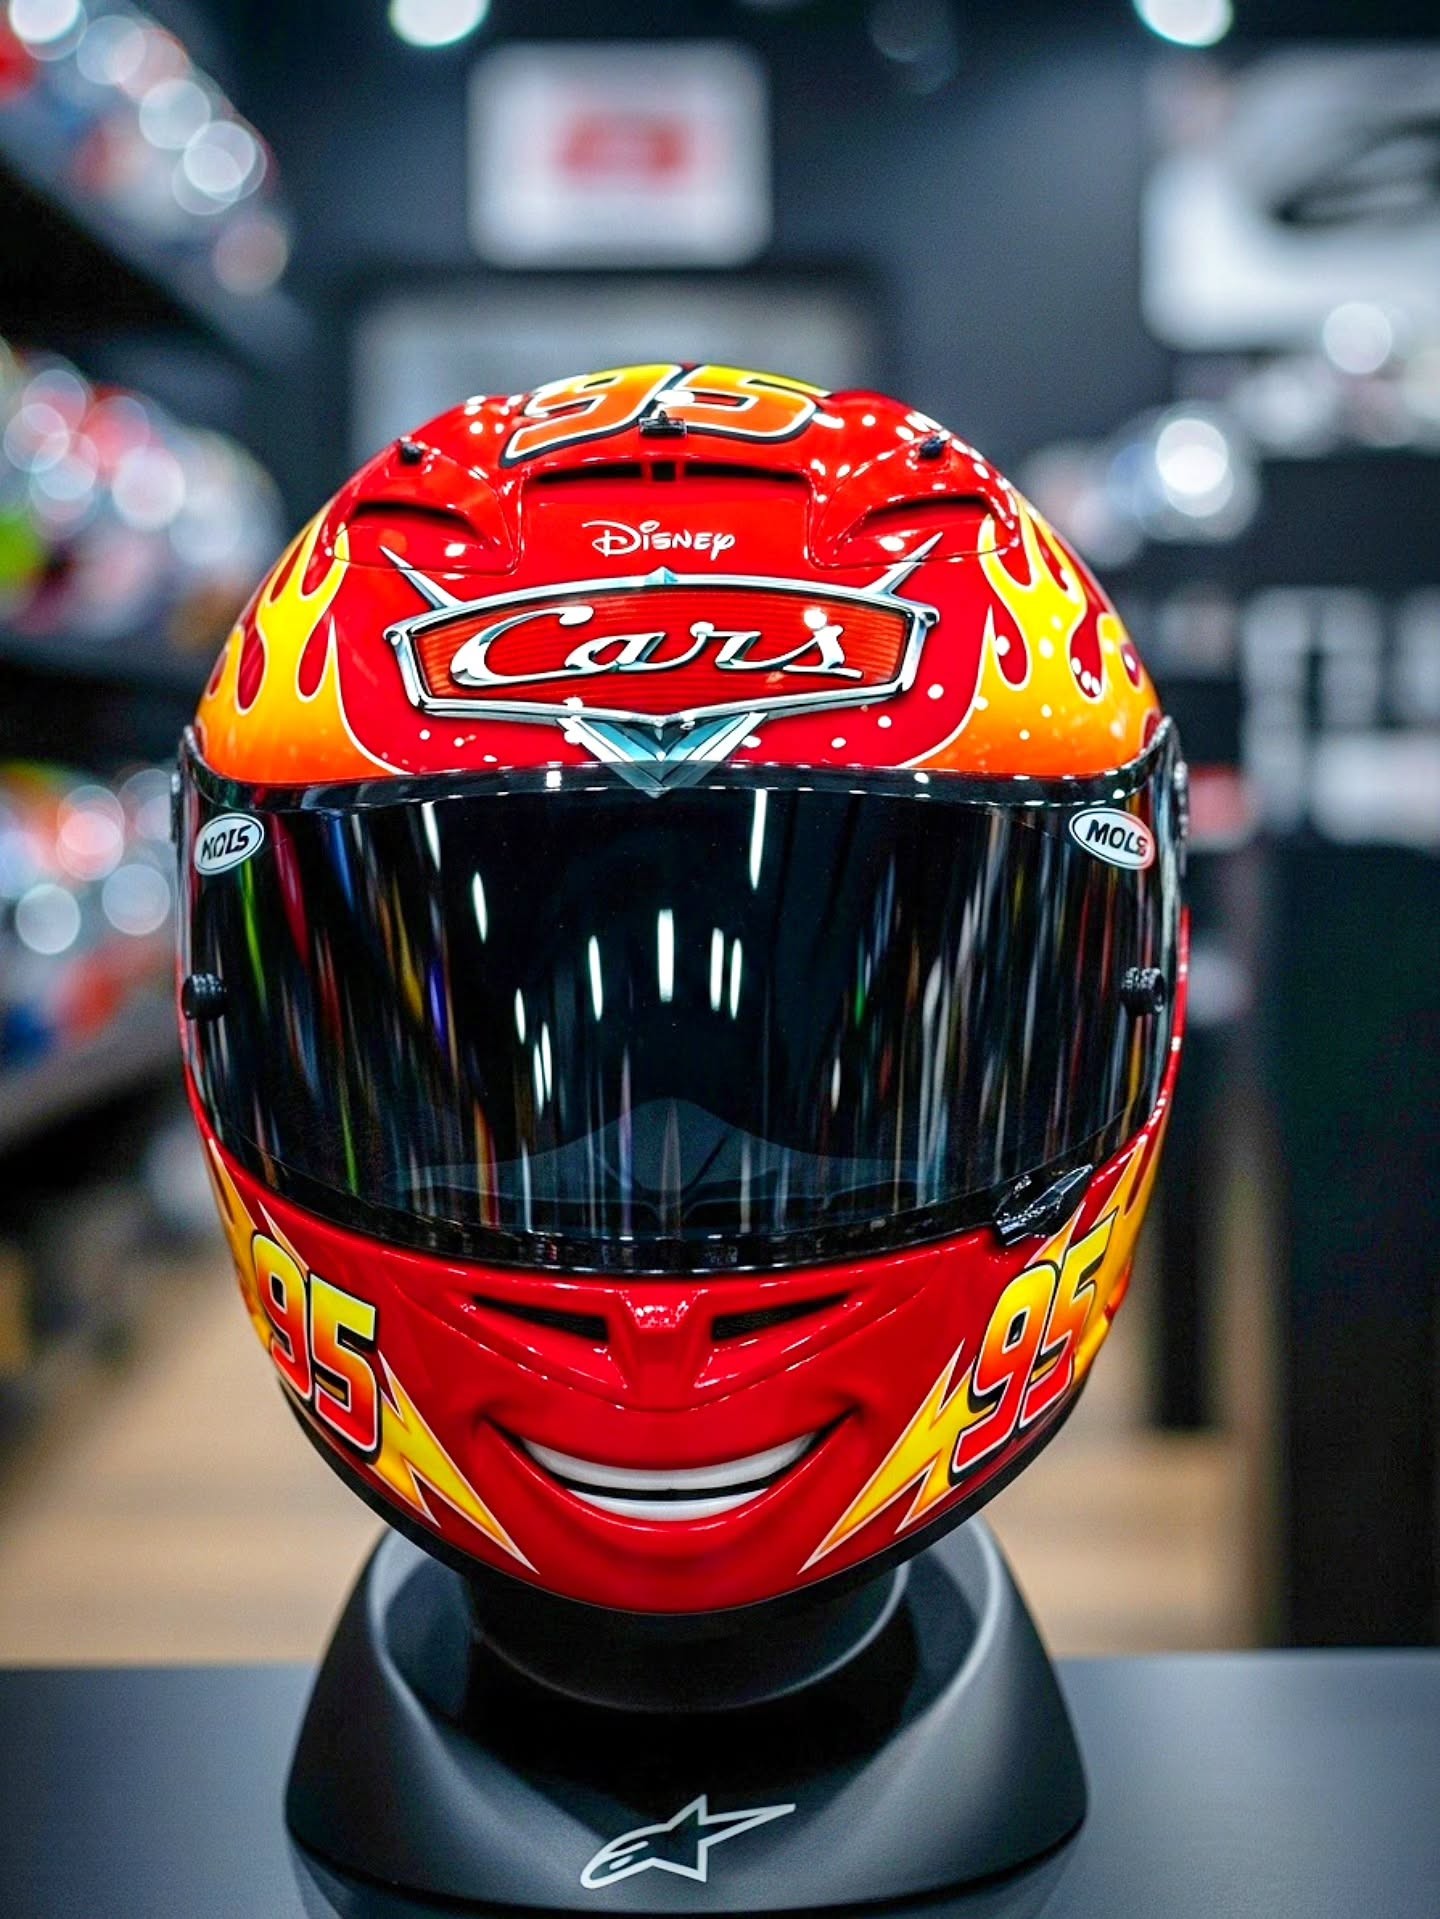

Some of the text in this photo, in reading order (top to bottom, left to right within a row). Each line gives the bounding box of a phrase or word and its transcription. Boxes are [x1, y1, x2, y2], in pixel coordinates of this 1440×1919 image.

[502, 363, 830, 464] 95
[449, 604, 863, 687] Cars
[252, 1233, 379, 1455] 95
[949, 1208, 1118, 1476] 95
